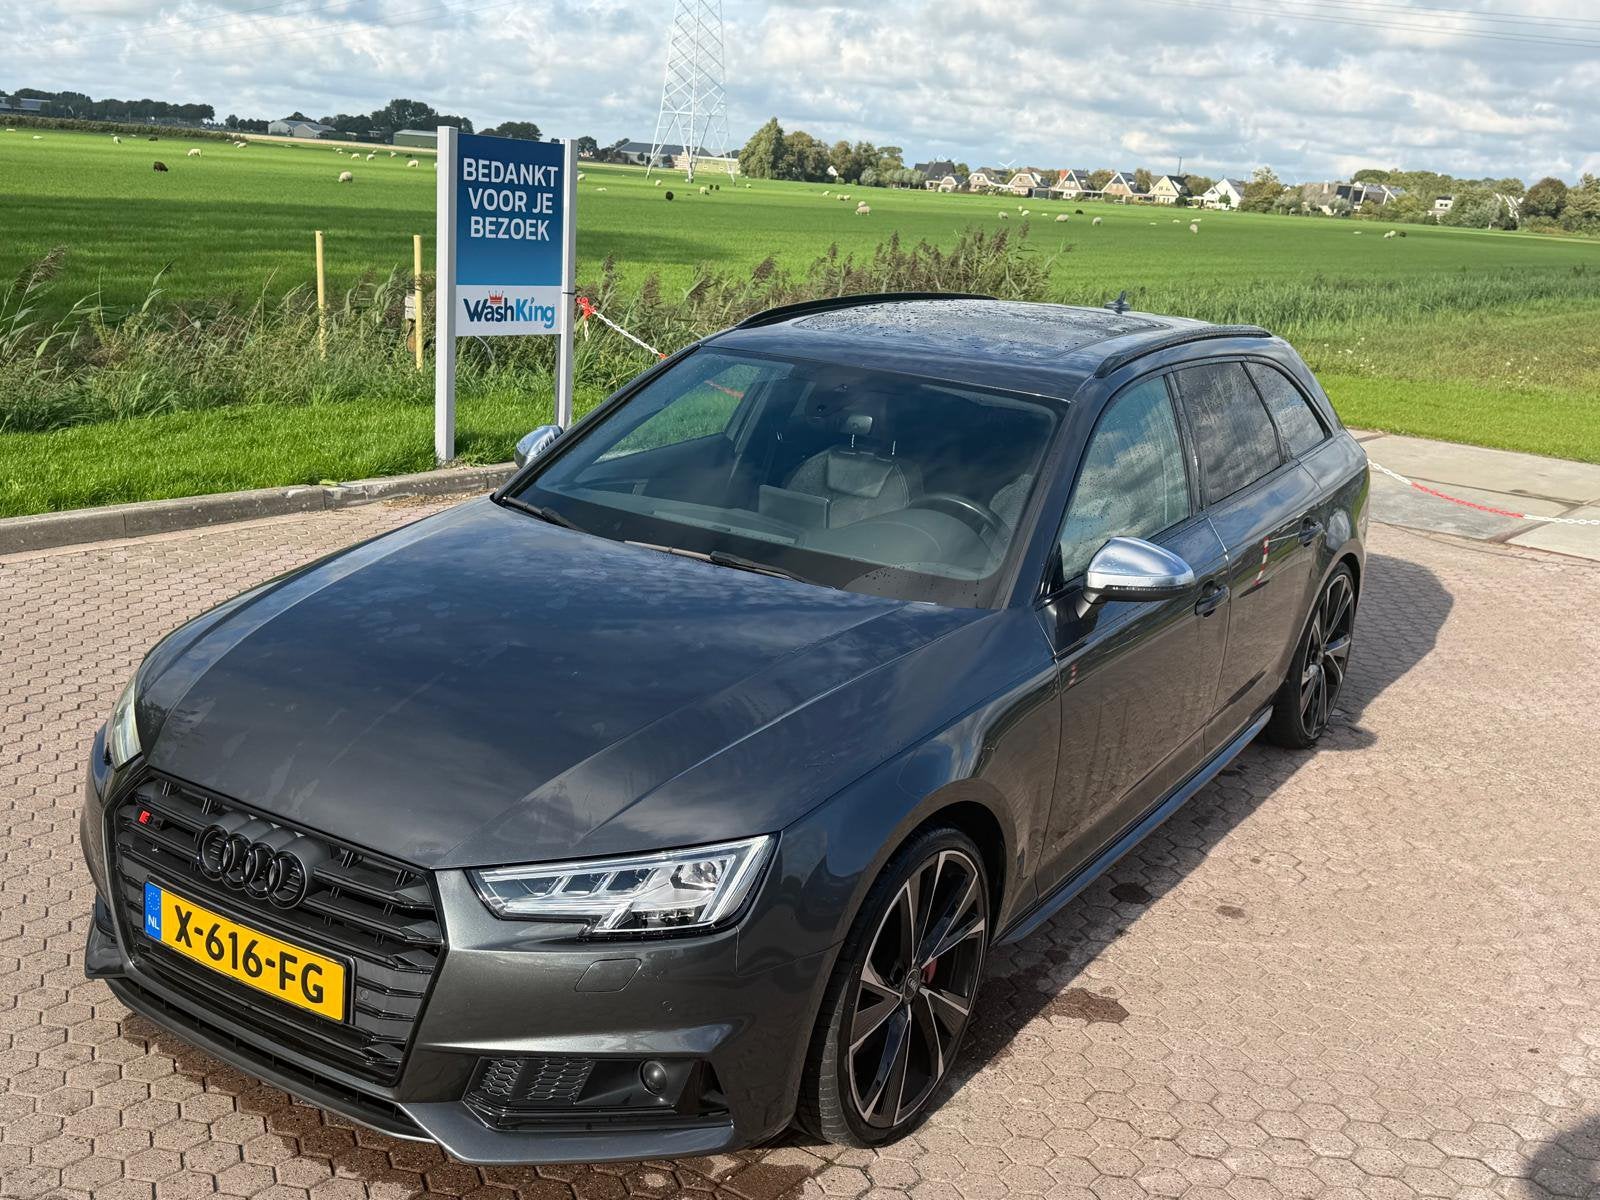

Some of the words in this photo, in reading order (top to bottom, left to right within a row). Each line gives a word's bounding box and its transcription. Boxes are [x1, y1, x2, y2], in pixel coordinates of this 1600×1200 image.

[463, 157, 559, 187] BEDANKT
[468, 188, 527, 213] VOOR
[532, 193, 553, 214] JE
[470, 216, 550, 241] BEZOEK
[463, 297, 555, 329] WashKing
[147, 914, 160, 931] NL
[174, 905, 324, 1004] X-616-FG
